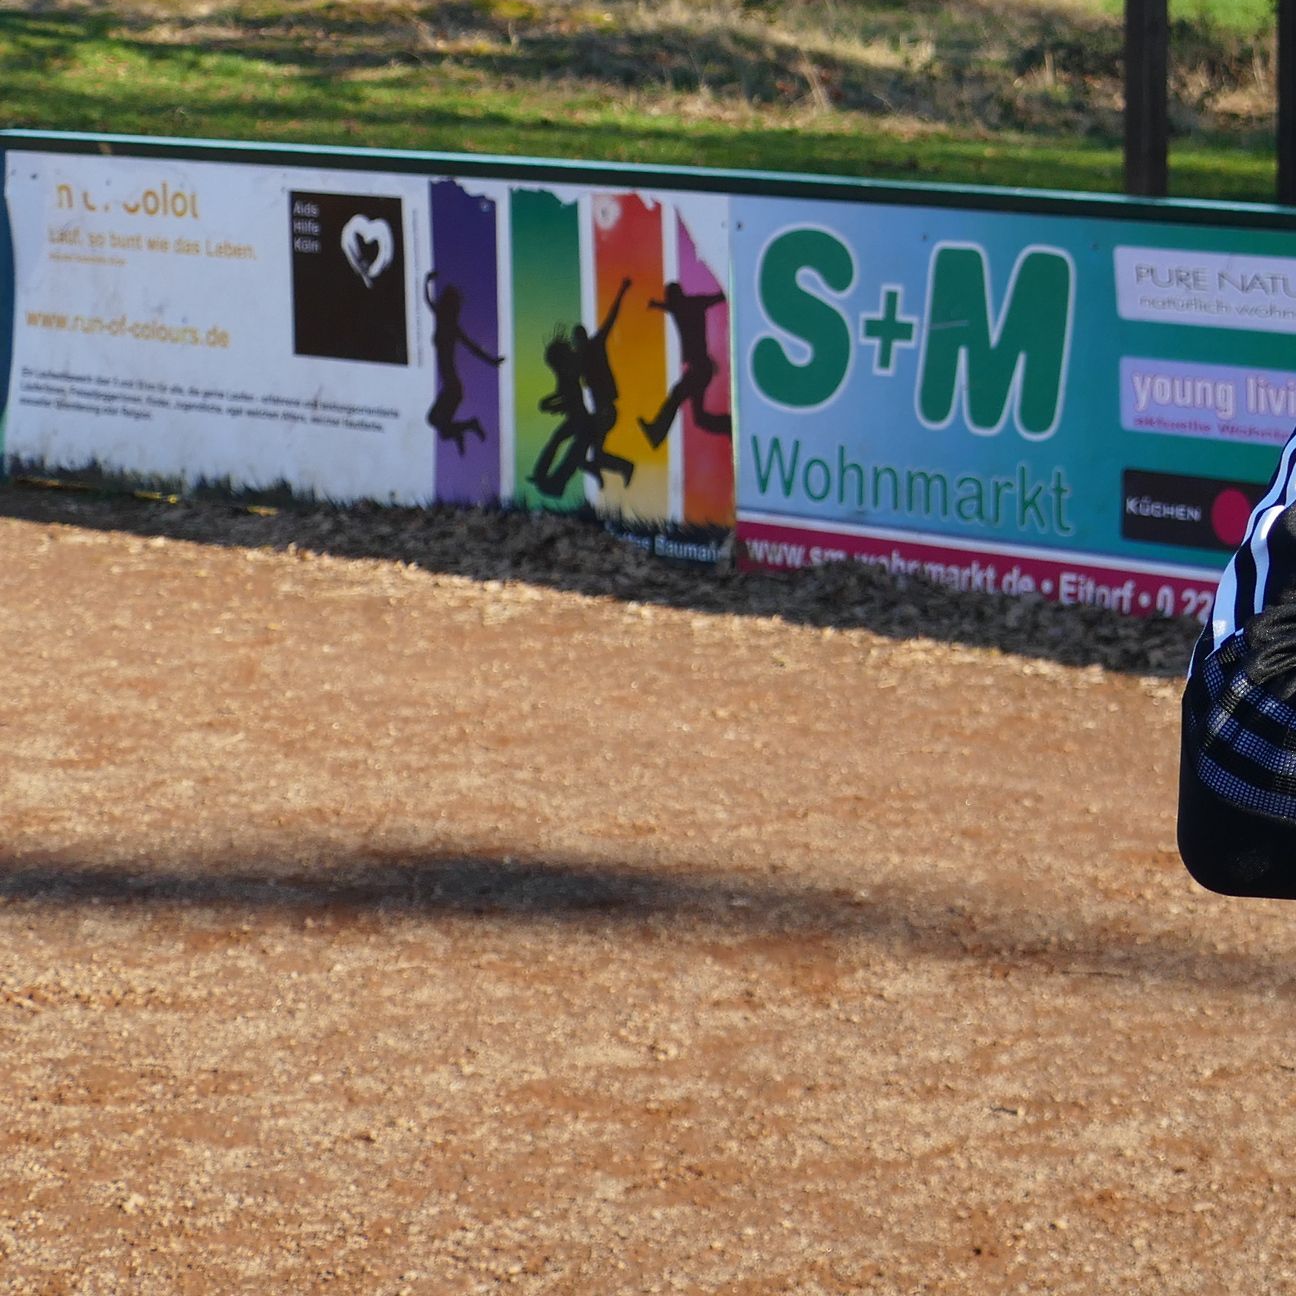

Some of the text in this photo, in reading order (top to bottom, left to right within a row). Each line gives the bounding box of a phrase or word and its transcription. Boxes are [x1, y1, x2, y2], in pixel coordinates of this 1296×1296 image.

[1135, 263, 1209, 293] PURE
[750, 224, 1075, 439] S+M
[1132, 373, 1236, 420] young
[750, 433, 1072, 534] Wohnmarkt
[1126, 494, 1203, 522] KÜCHEN
